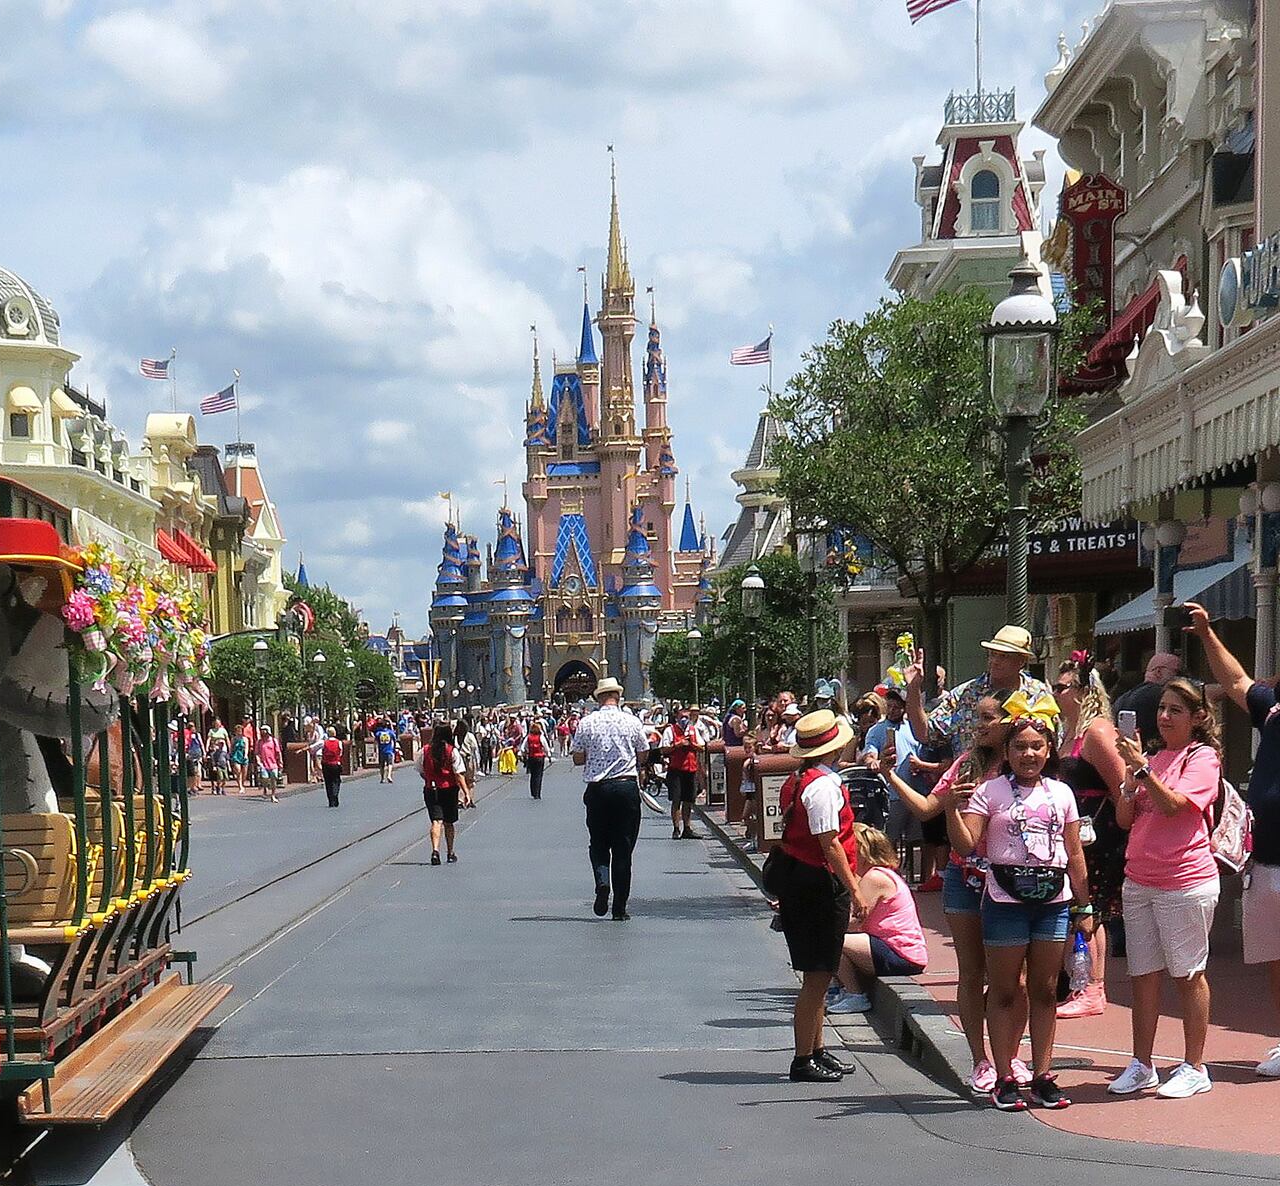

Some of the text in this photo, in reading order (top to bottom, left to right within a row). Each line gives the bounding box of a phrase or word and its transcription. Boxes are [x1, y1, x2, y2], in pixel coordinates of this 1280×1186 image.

[1068, 189, 1117, 210] MAIN
[1049, 539, 1060, 553] &
[1067, 532, 1136, 552] TREATS"
